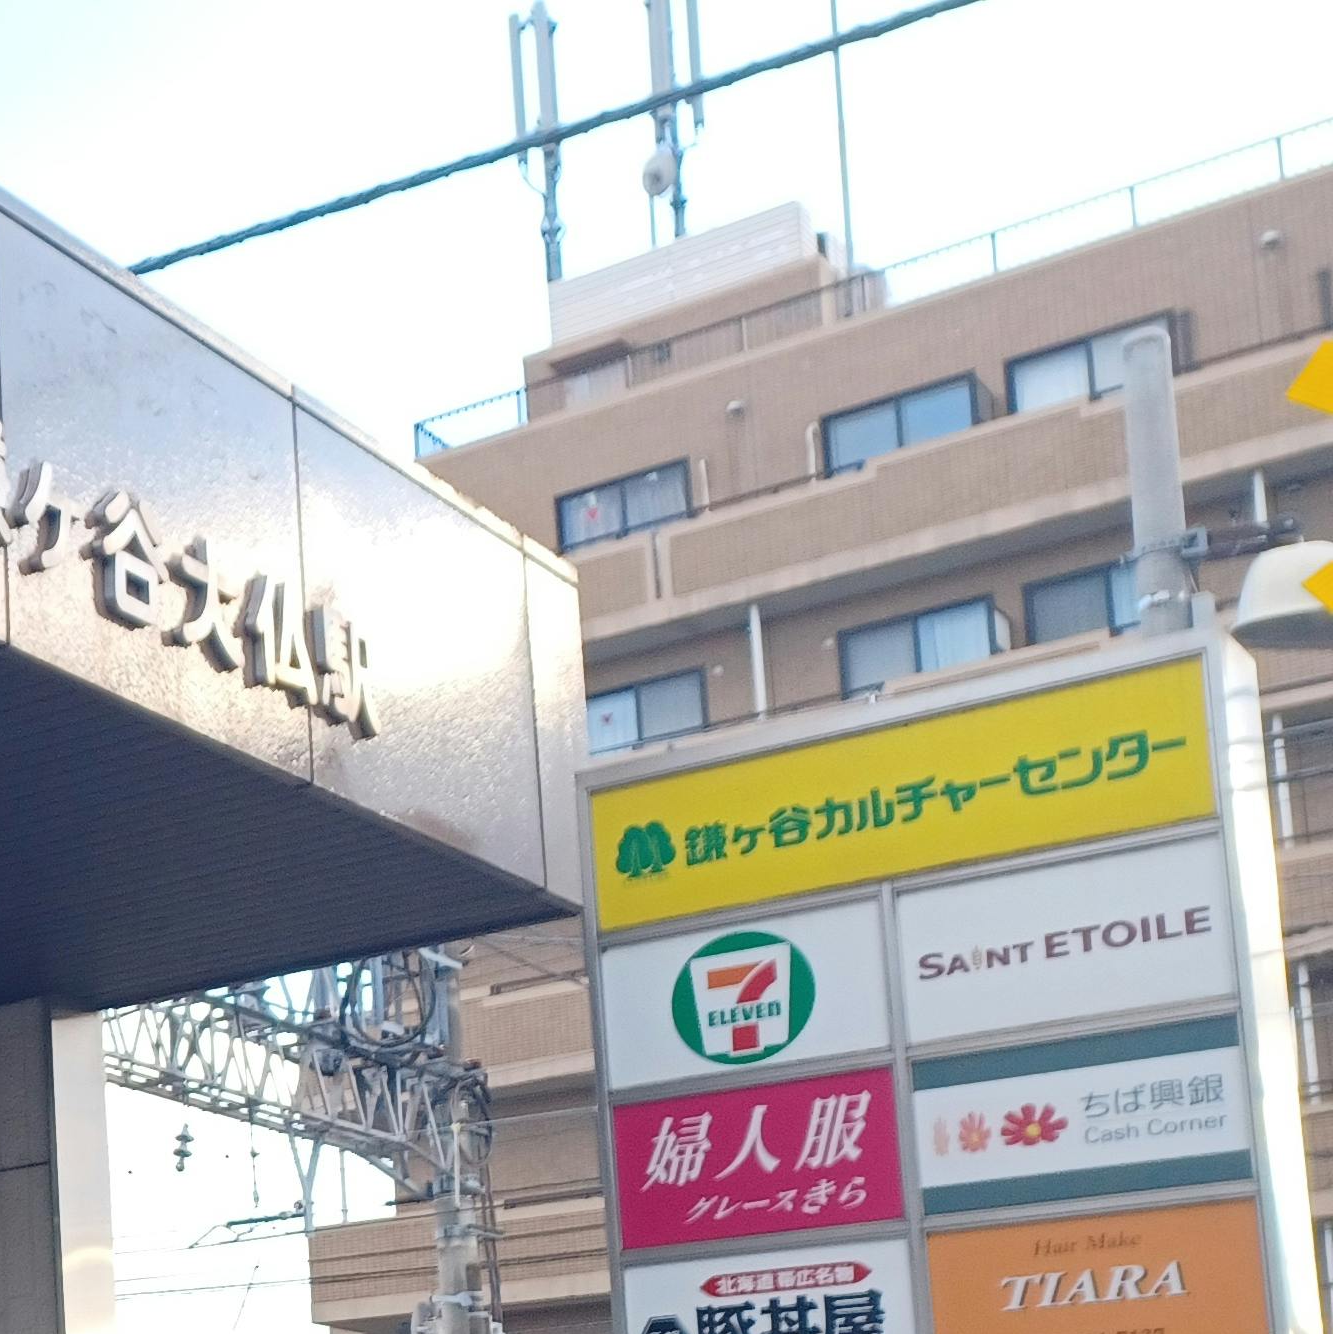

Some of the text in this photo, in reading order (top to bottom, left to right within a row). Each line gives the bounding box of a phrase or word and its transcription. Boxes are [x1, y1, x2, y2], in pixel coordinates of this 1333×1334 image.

[1045, 906, 1213, 961] ETOILE
[1080, 1073, 1224, 1119] ちば興銀
[640, 1090, 872, 1193] 婦人服
[1084, 1114, 1228, 1144] Cash Corner
[683, 1176, 868, 1225] グレースきら
[1034, 1231, 1143, 1257] Hair Make
[999, 1259, 1191, 1312] TIARA
